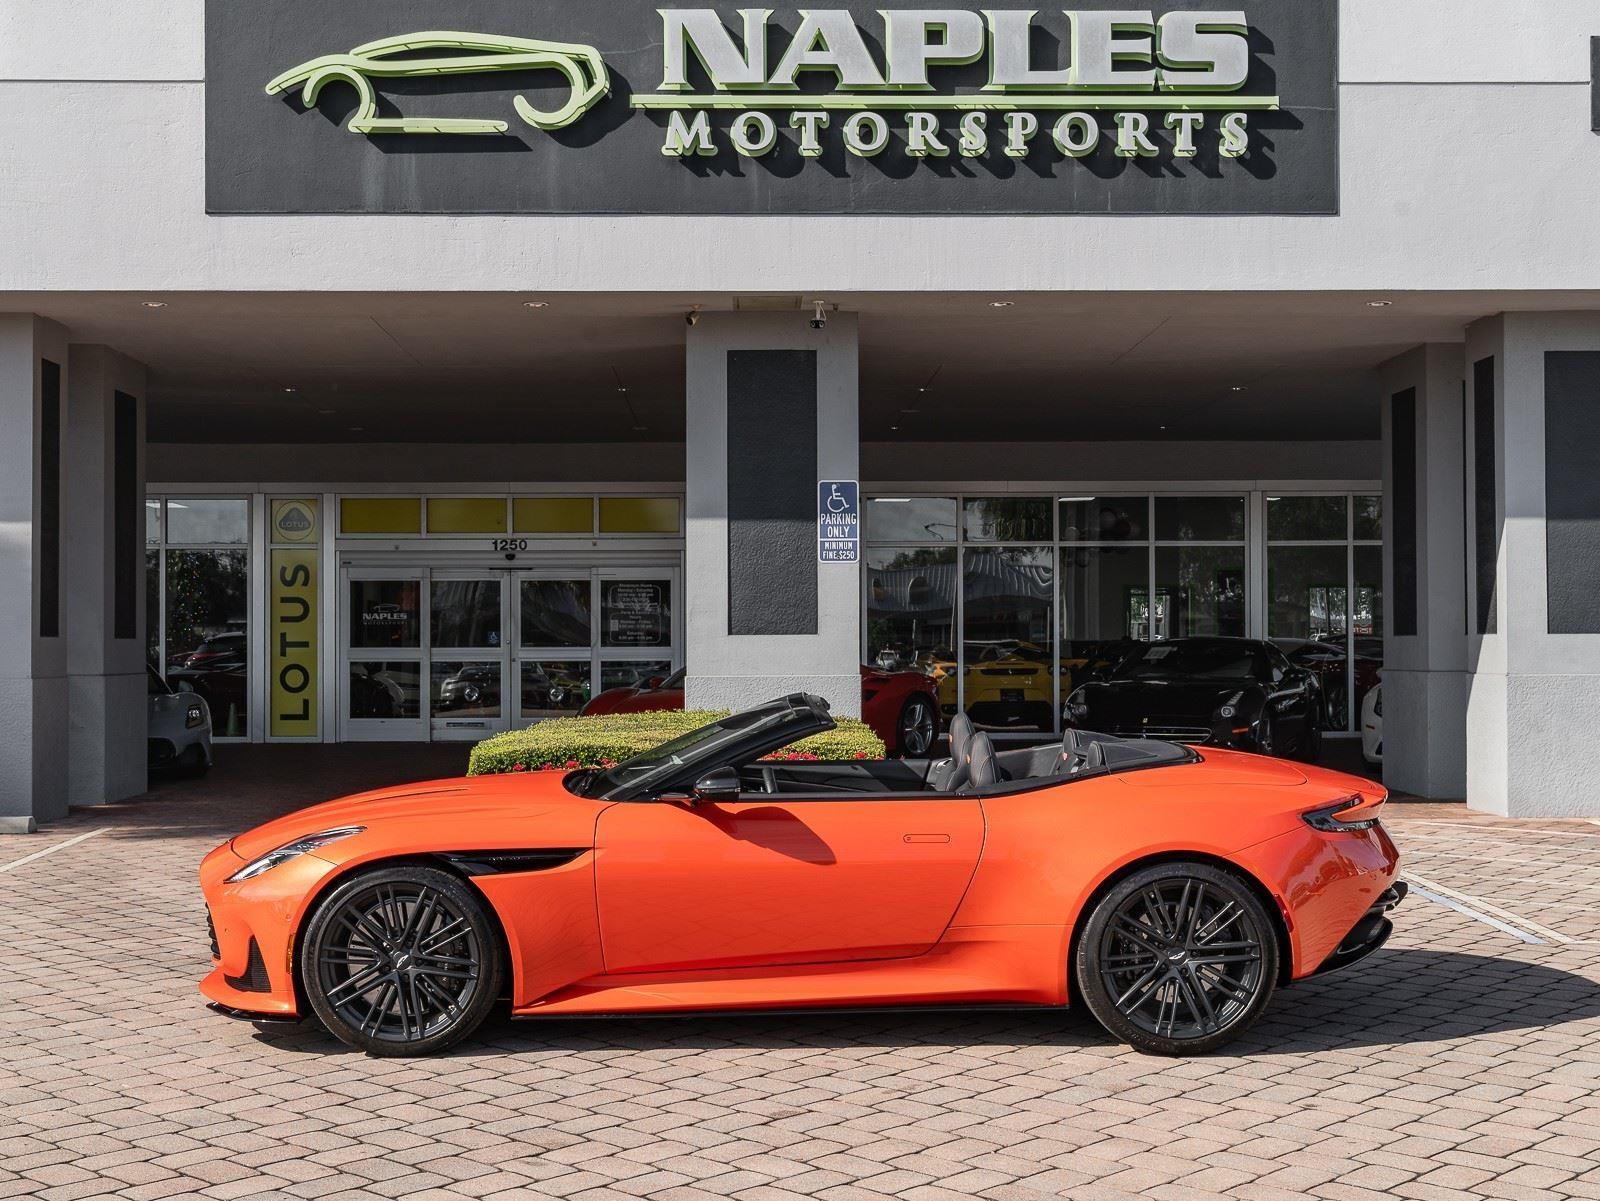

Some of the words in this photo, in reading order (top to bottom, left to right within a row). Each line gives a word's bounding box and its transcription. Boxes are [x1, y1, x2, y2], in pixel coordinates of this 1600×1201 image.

[657, 8, 1250, 91] NAPLES
[661, 110, 1251, 157] MOTORSPORTS
[820, 513, 857, 525] PARKING
[827, 526, 850, 538] ONLY
[492, 539, 528, 551] 1250
[824, 541, 853, 550] MINIMUM
[362, 612, 408, 620] NAPLES
[279, 564, 310, 721] LOTUS
